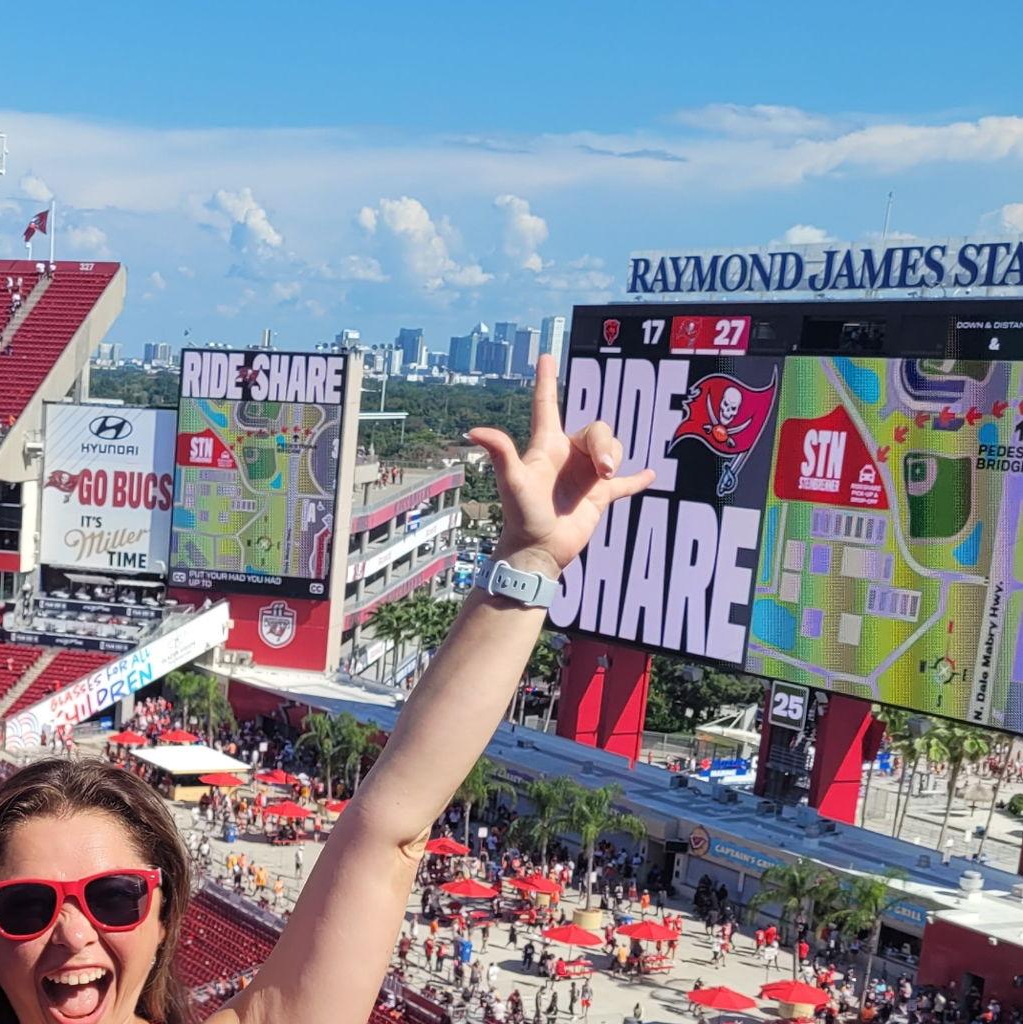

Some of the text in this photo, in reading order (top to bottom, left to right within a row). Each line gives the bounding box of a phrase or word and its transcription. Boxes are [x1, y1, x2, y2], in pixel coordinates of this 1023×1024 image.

[79, 263, 95, 271] 327
[627, 251, 805, 294] RAYMOND
[809, 246, 946, 293] JAMES
[641, 320, 666, 345] 17
[713, 319, 746, 346] 27
[957, 321, 984, 329] DOWN
[984, 321, 992, 329] &
[988, 337, 1000, 350] &
[181, 352, 346, 404] RIDE SHARE
[80, 442, 139, 456] HYUNDAI
[190, 436, 213, 458] STN
[800, 429, 847, 479] STN
[978, 444, 1023, 459] PEDES
[79, 470, 173, 512] GO BUCS
[80, 515, 103, 528] IT'S
[64, 526, 150, 562] Miller
[107, 551, 147, 569] TIME
[188, 569, 205, 578] PUT
[205, 571, 228, 580] YOUR
[247, 574, 263, 583] YOU
[188, 578, 213, 588] UP TO
[974, 580, 1004, 721] N. Dale Mabry Hwy.
[106, 659, 128, 680] FOR
[132, 648, 150, 666] ALL
[772, 691, 804, 720] 25
